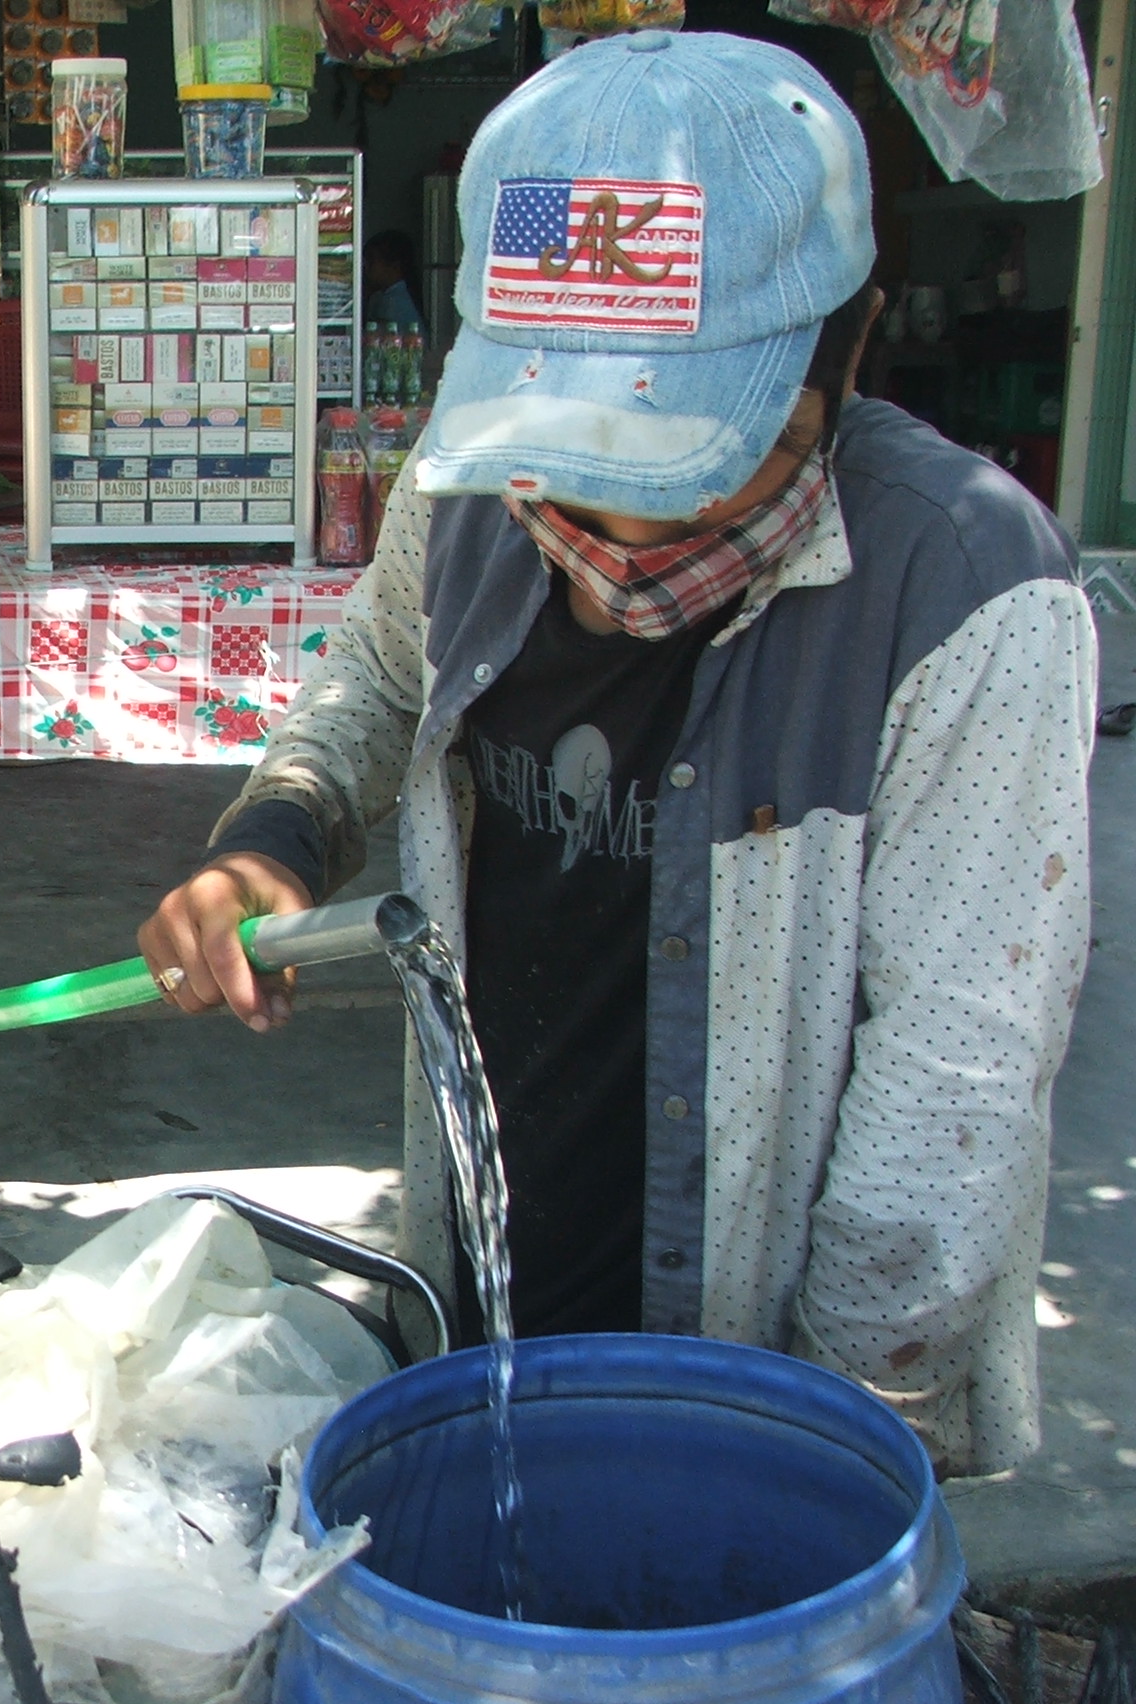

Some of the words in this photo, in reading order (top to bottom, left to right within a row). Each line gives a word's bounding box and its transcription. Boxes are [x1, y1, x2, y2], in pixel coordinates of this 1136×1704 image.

[538, 190, 672, 284] AK
[634, 231, 692, 255] CAPS
[202, 284, 242, 299] BASTOS
[251, 283, 291, 298] BASTOS
[100, 339, 114, 379] BASTOS
[55, 483, 94, 497] BASTOS
[104, 482, 143, 496] BASTOS
[154, 480, 193, 495] BASTOS
[202, 480, 240, 495] BASTOS
[250, 480, 289, 495] BASTOS
